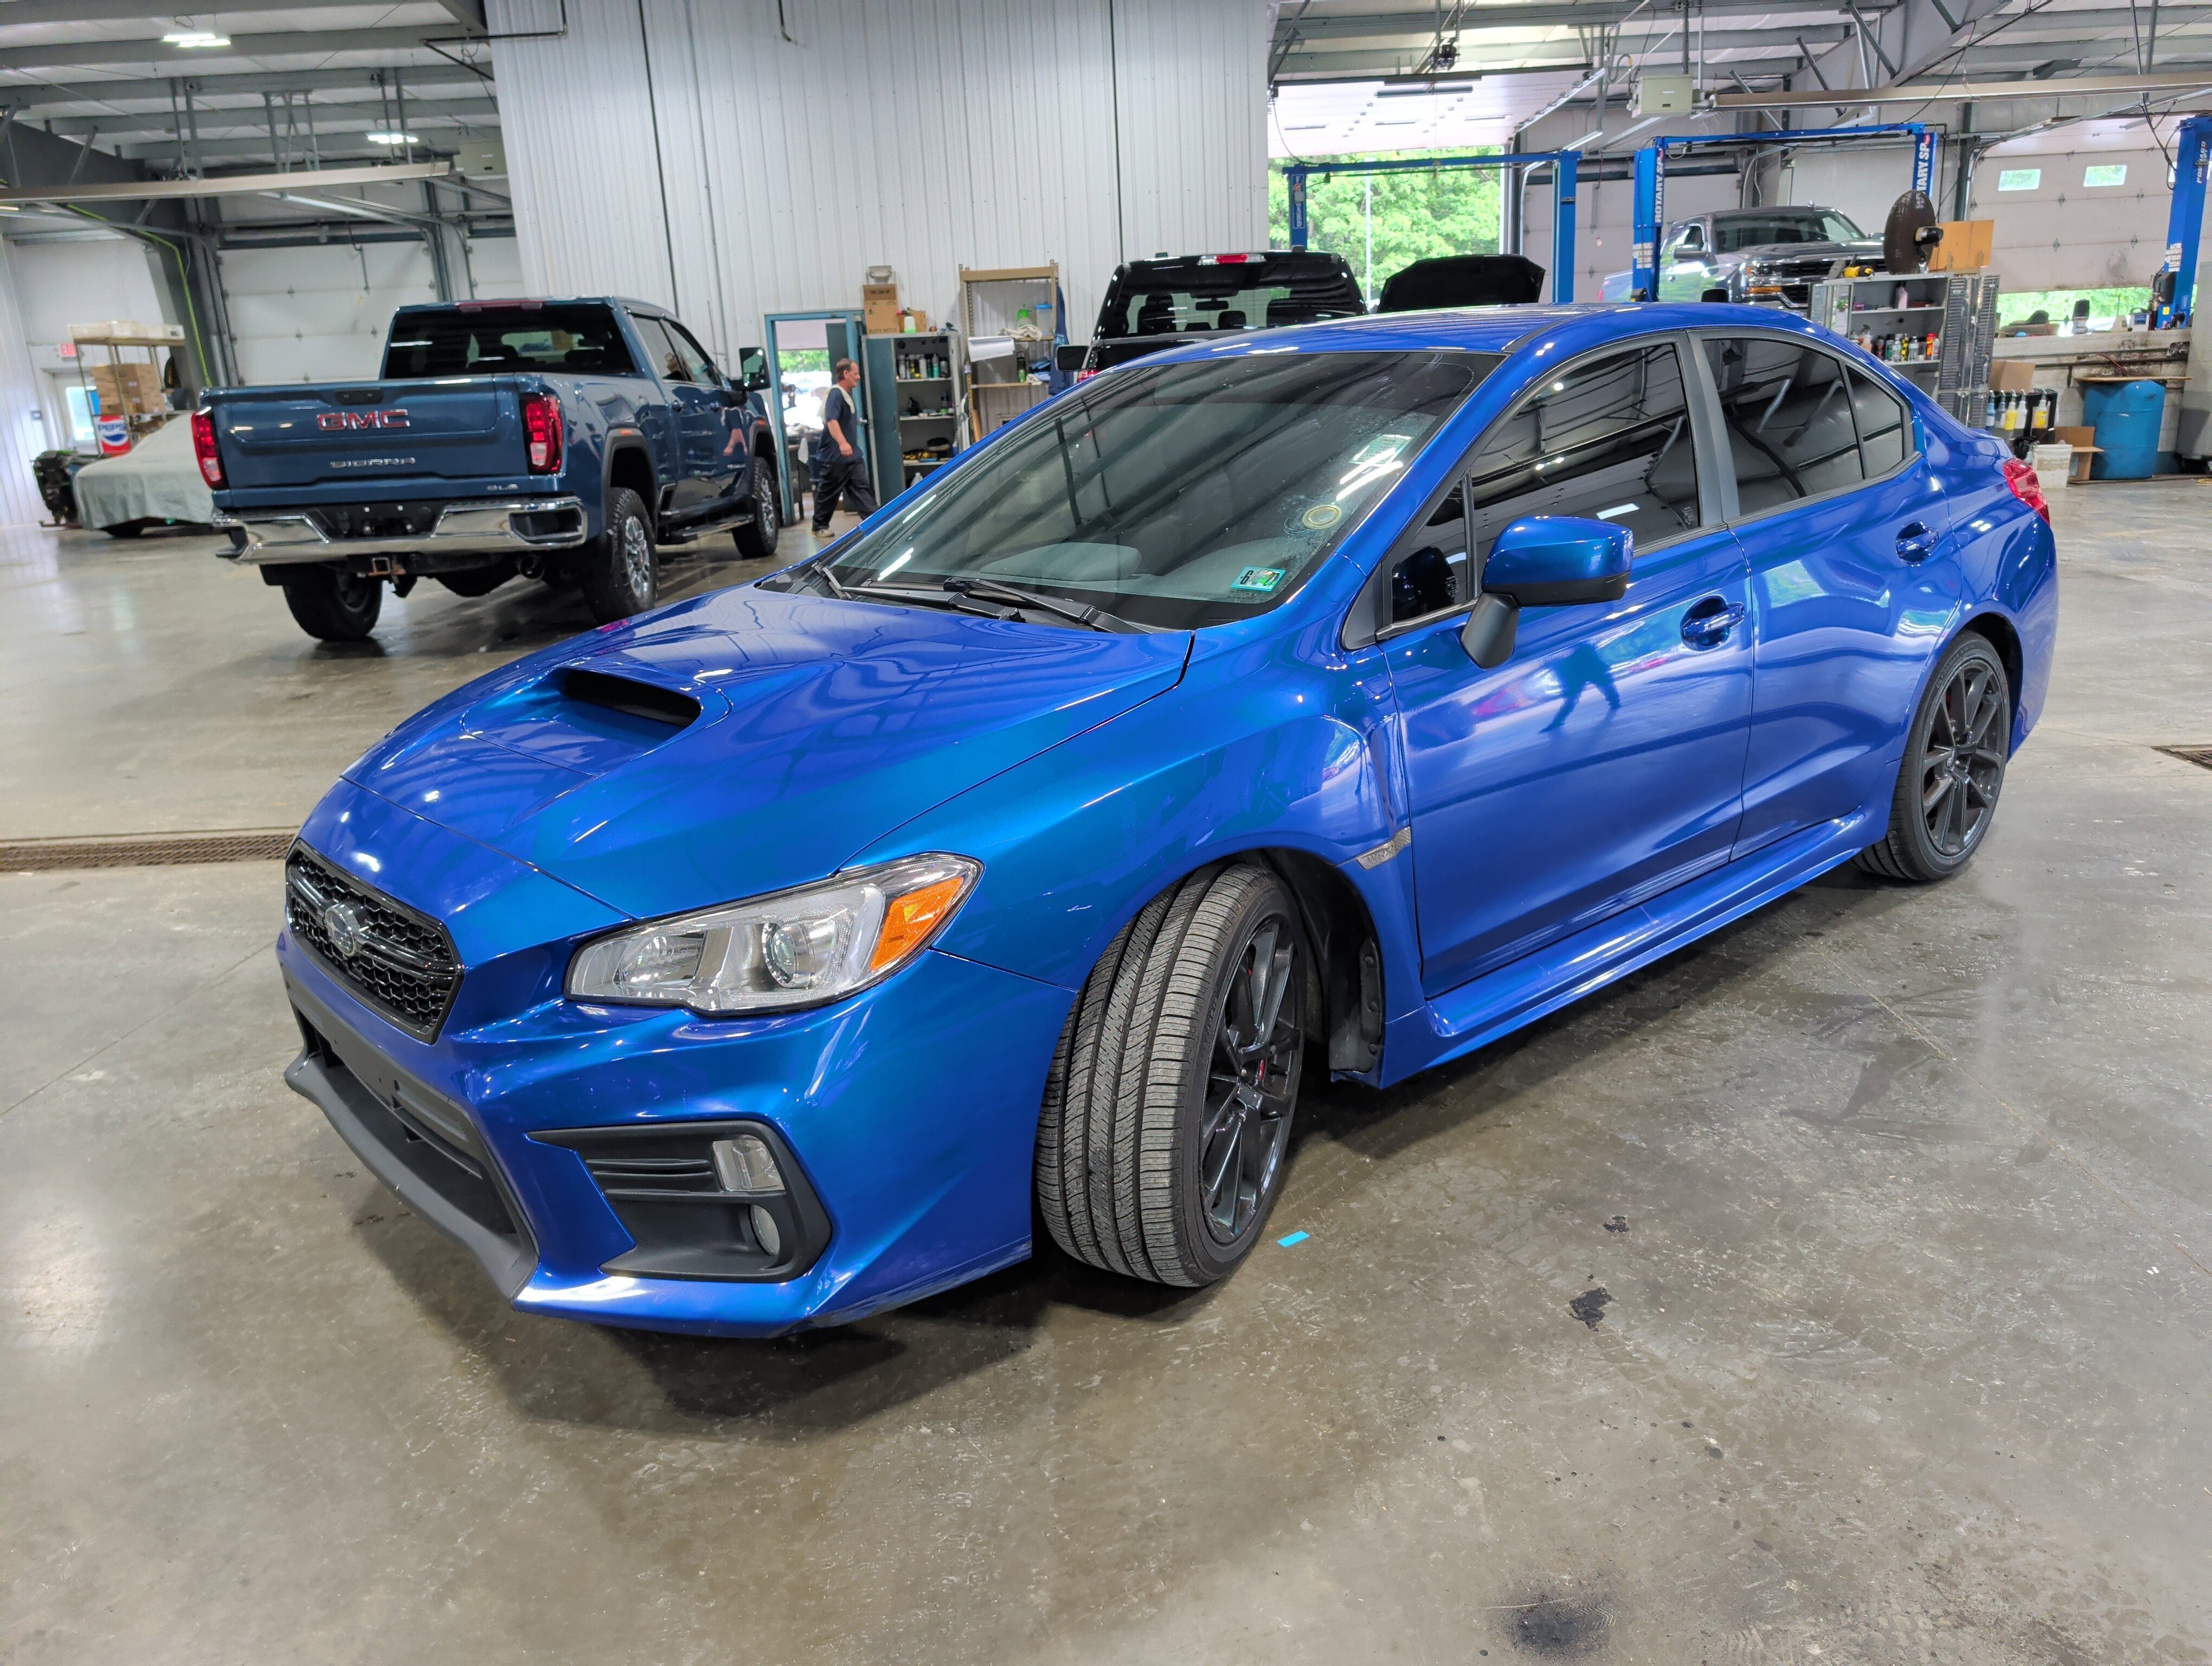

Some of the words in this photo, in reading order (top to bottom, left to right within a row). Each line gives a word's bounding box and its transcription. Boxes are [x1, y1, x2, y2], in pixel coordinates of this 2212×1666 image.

[1915, 161, 1928, 209] TARY
[317, 409, 410, 431] GMC
[330, 457, 416, 469] SIERRA
[1367, 844, 1394, 866] WRX
